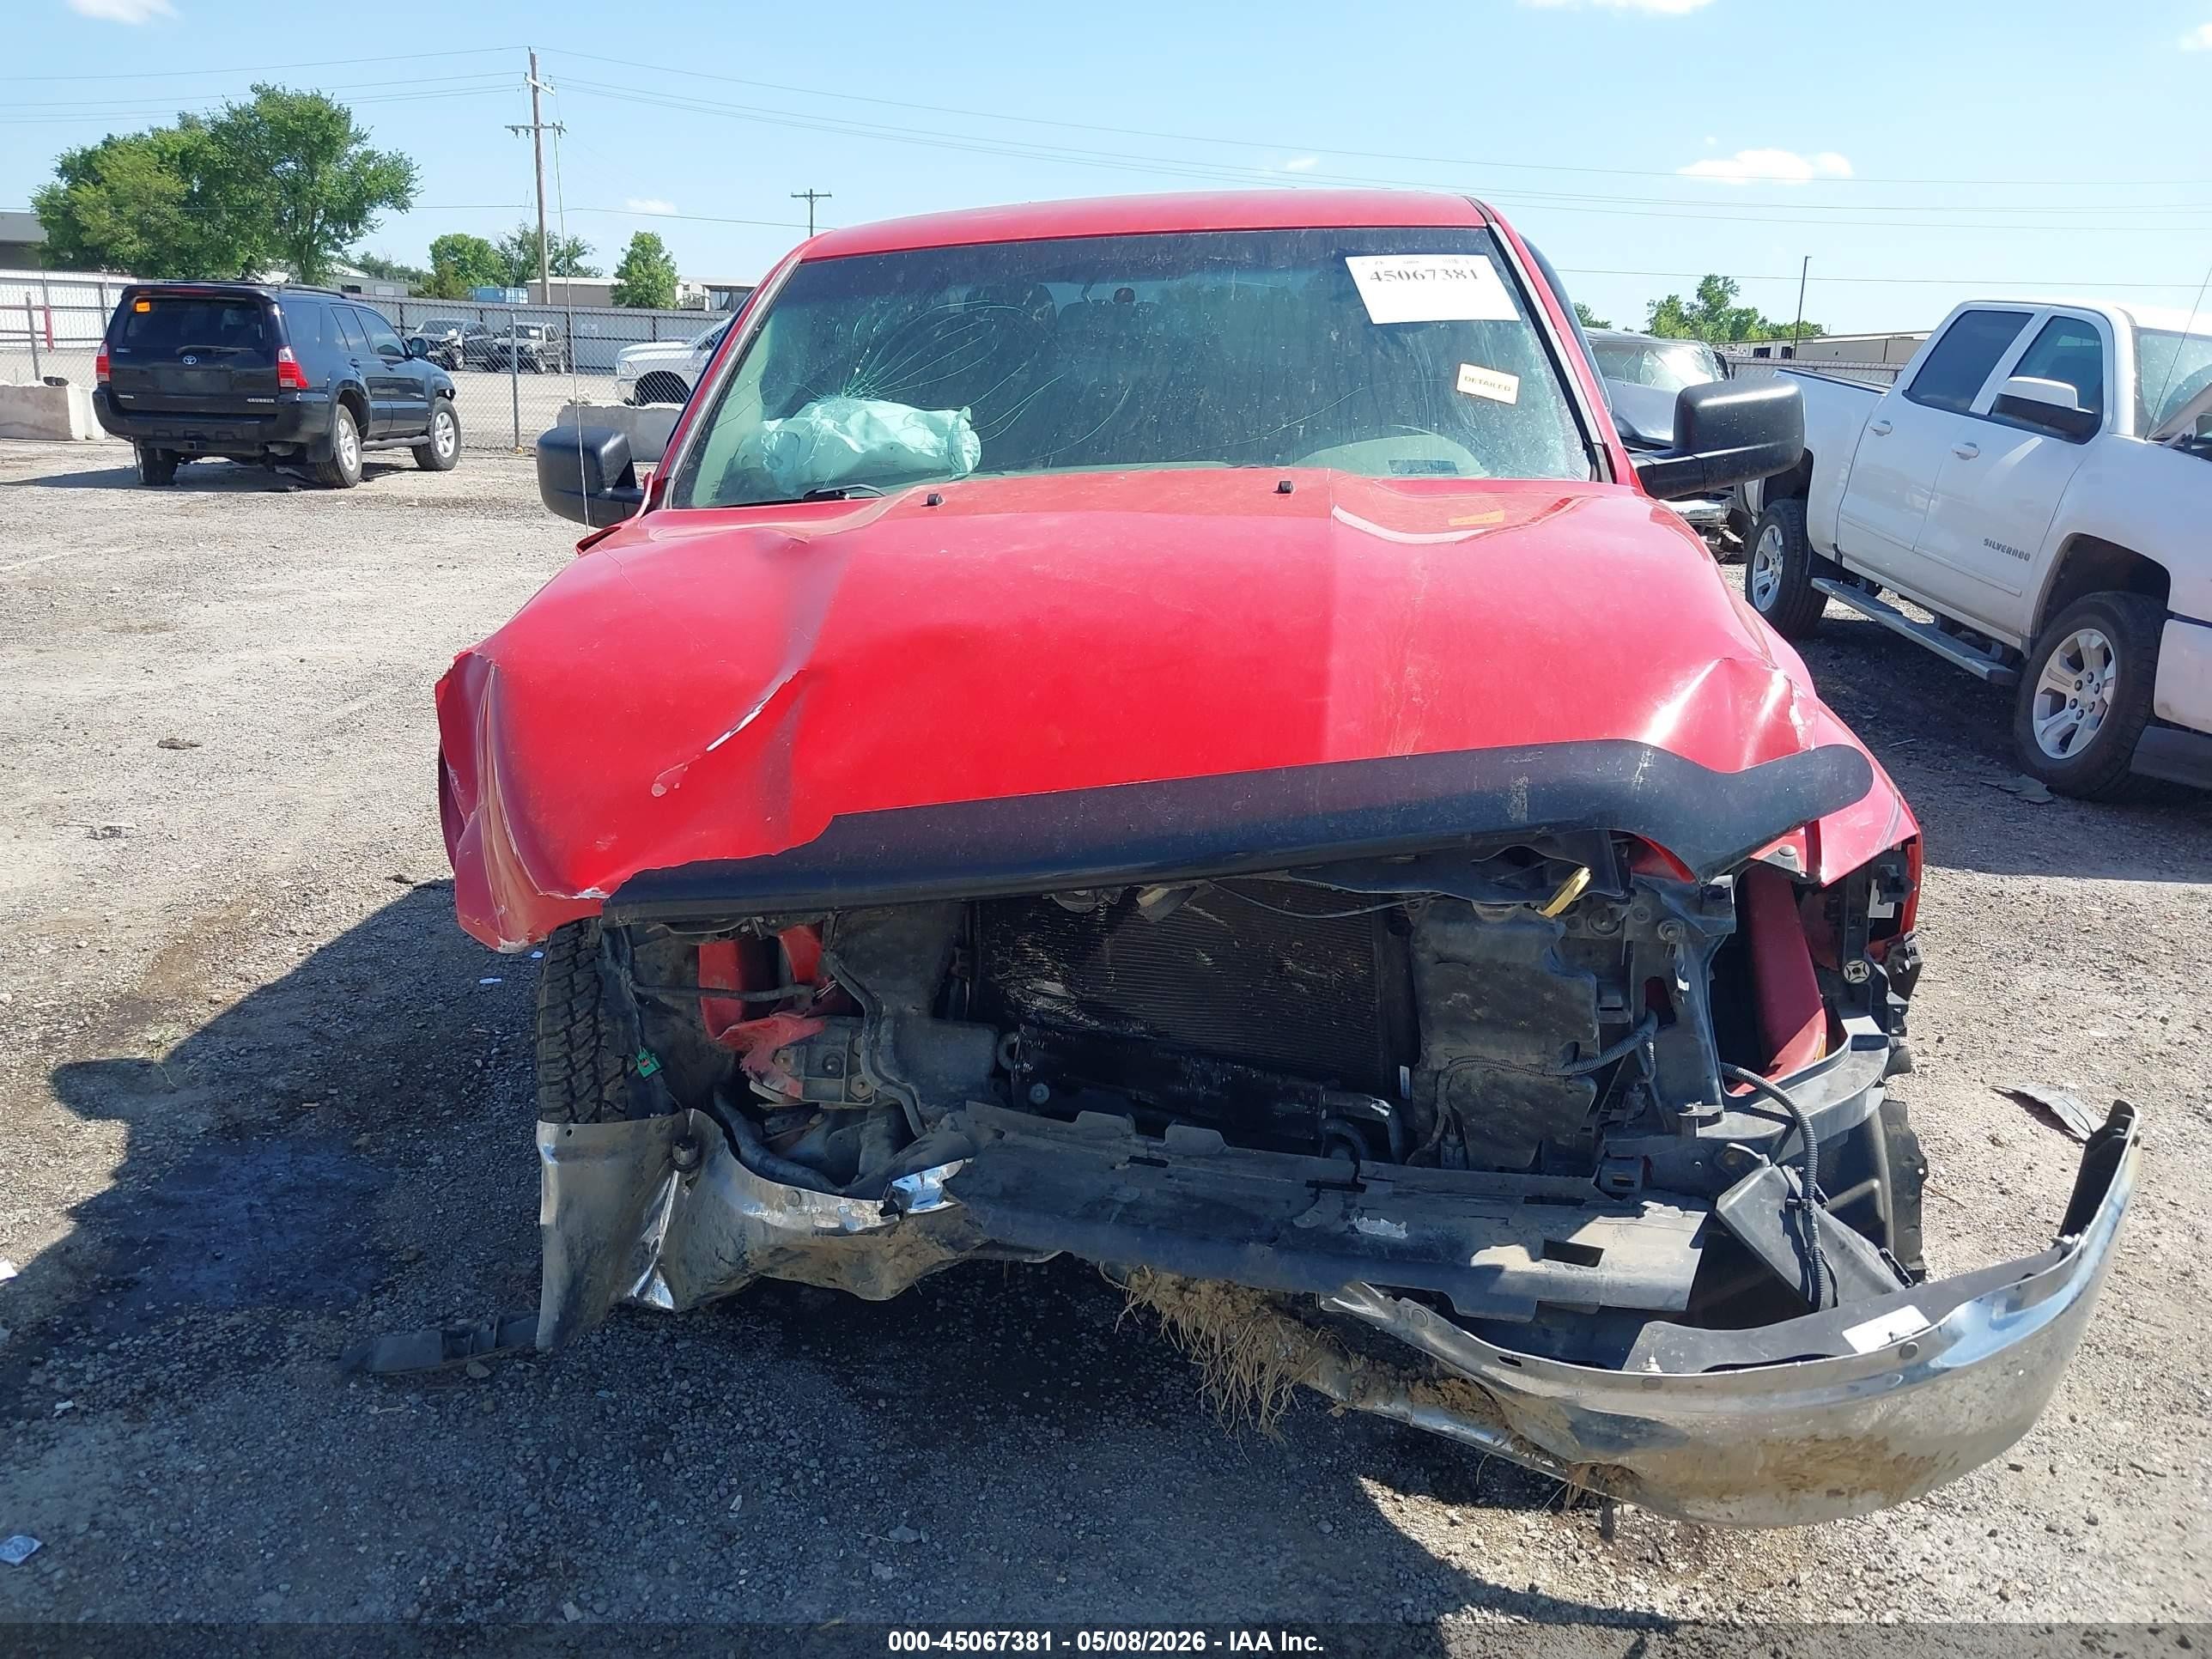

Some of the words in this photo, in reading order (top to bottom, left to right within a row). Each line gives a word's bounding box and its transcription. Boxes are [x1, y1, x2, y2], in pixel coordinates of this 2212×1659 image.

[1369, 268, 1479, 282] 45067381
[1463, 374, 1512, 392] DETAILED
[1983, 538, 2031, 562] SILVERADO
